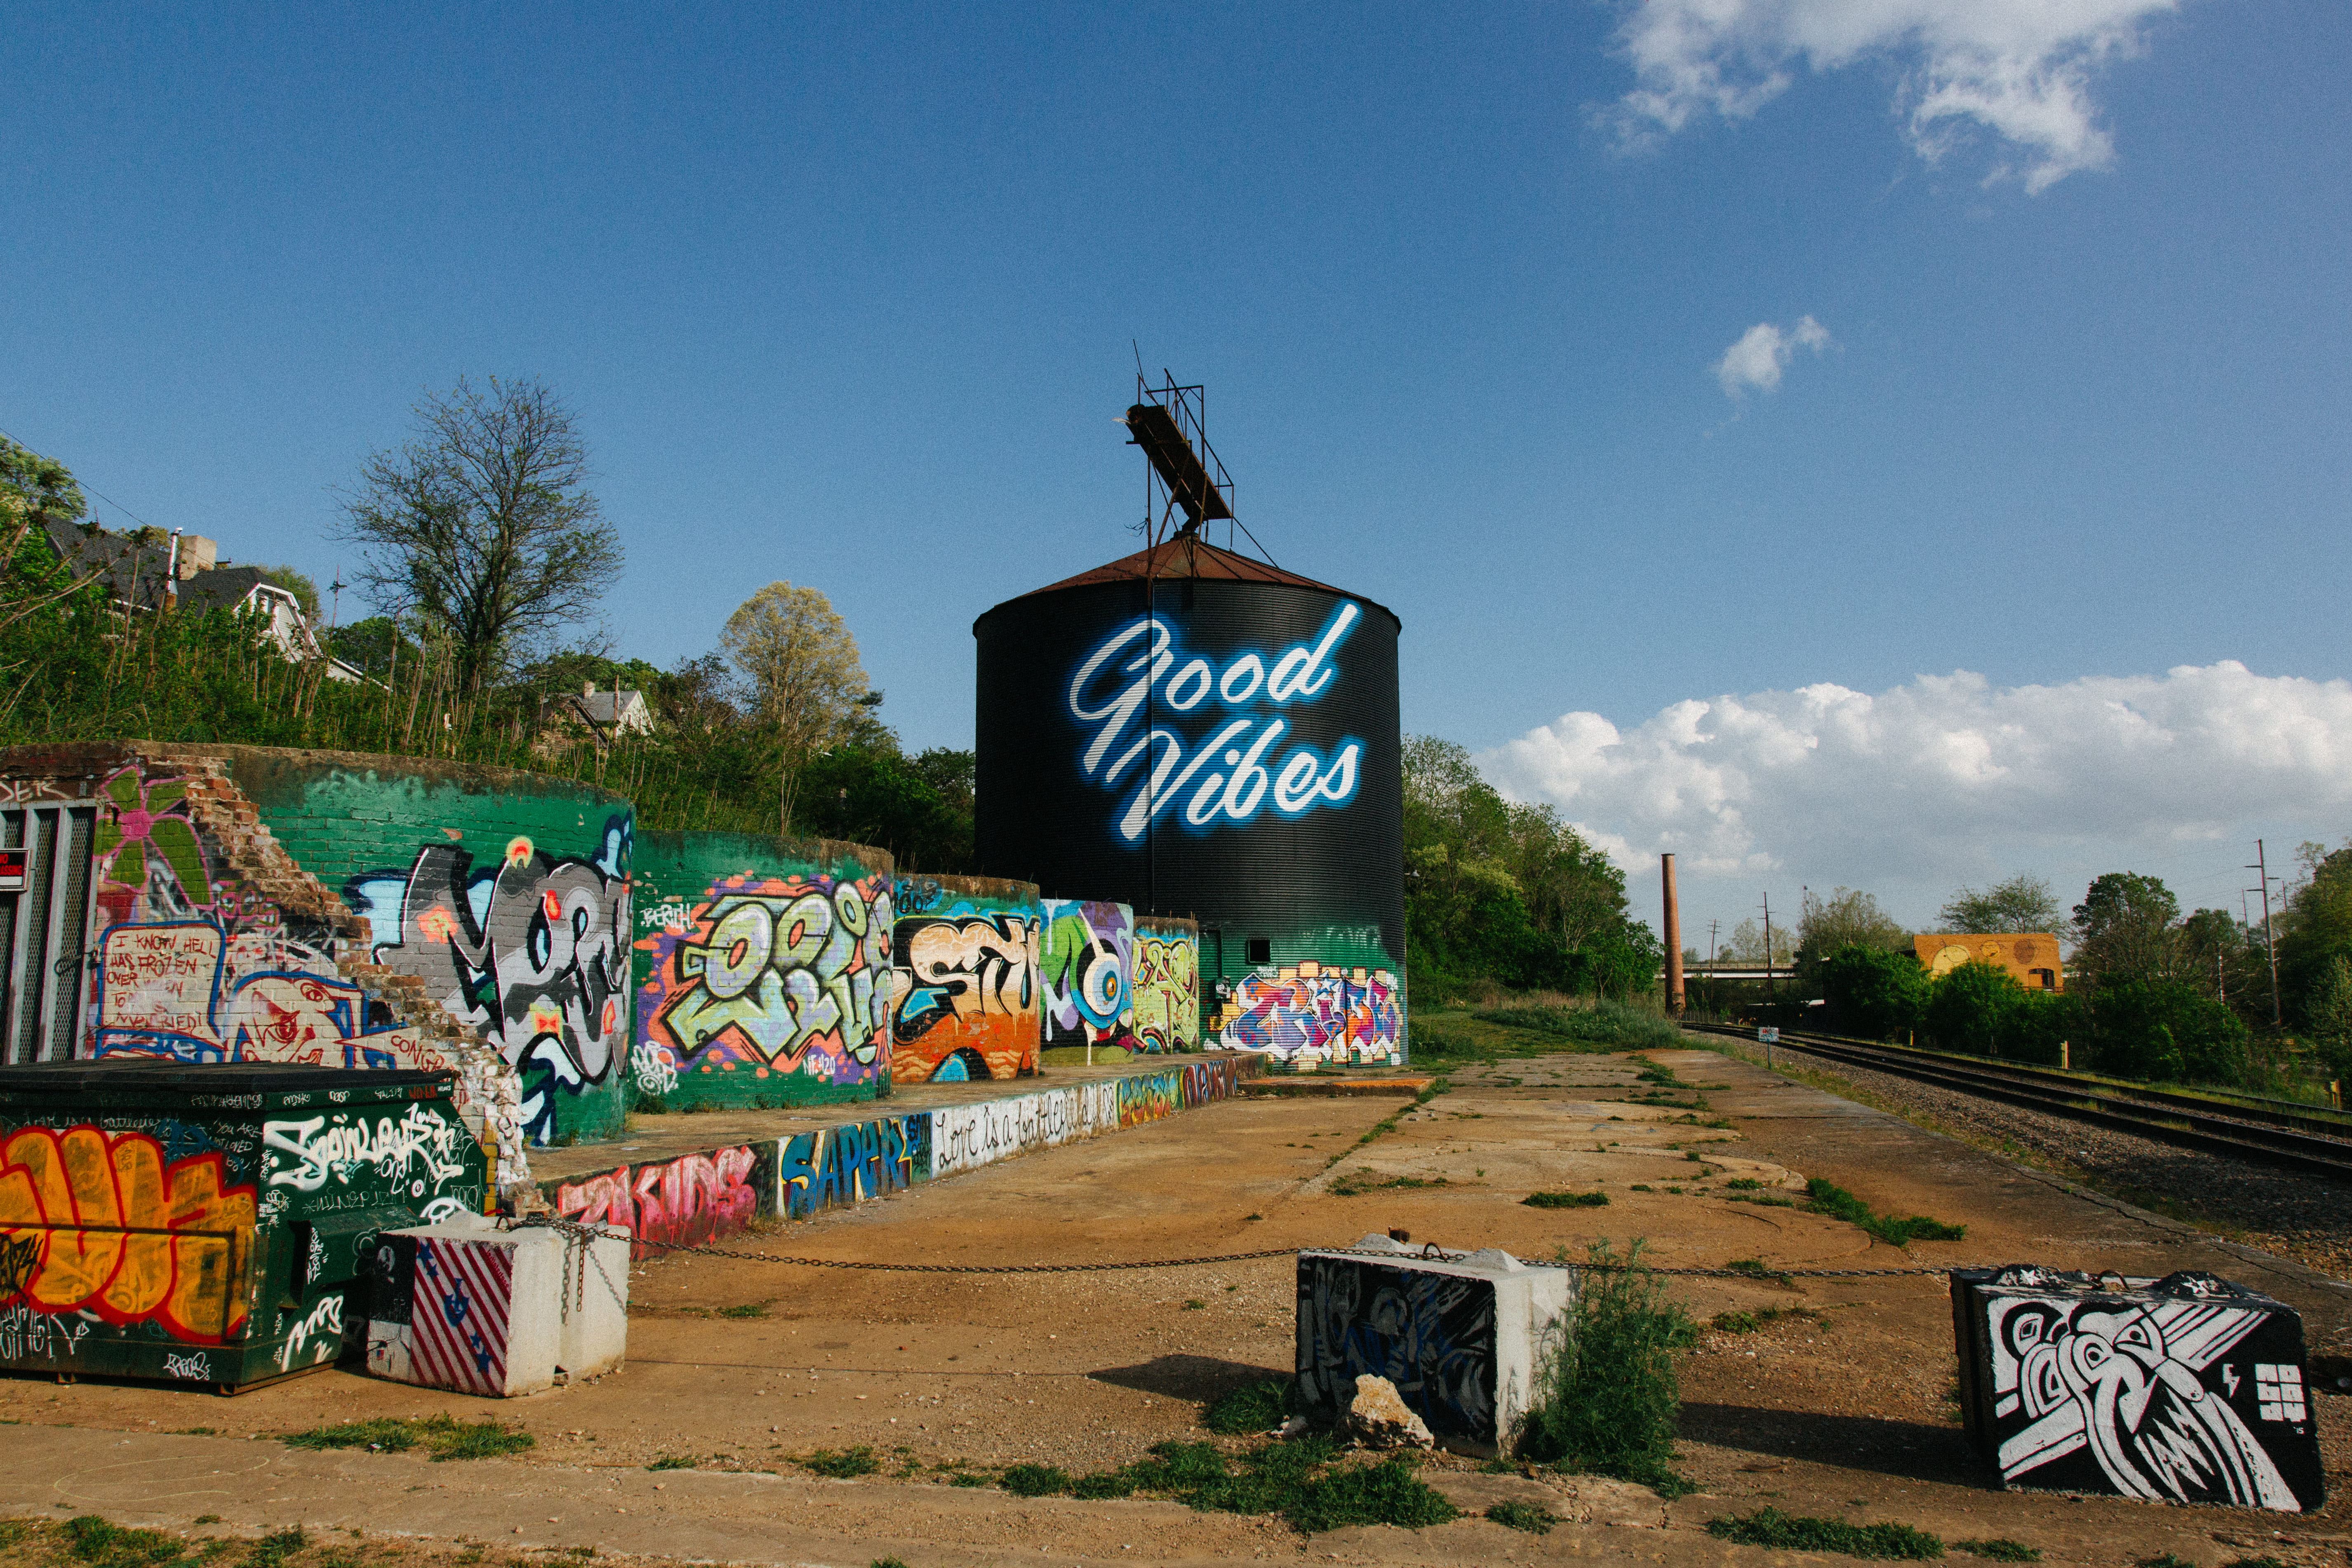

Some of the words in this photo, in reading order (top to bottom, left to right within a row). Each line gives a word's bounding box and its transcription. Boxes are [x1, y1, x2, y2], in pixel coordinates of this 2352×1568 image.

[1070, 603, 1357, 774] Good
[1106, 719, 1359, 840] Vibes
[110, 953, 135, 970] HAS
[137, 954, 197, 977] FROZEN
[113, 936, 129, 947] I
[136, 933, 177, 950] KNOW
[184, 936, 217, 959] HELL
[106, 971, 139, 988] OVER
[936, 1112, 978, 1169] Love
[982, 1105, 1000, 1152] is
[1003, 1114, 1013, 1146] a
